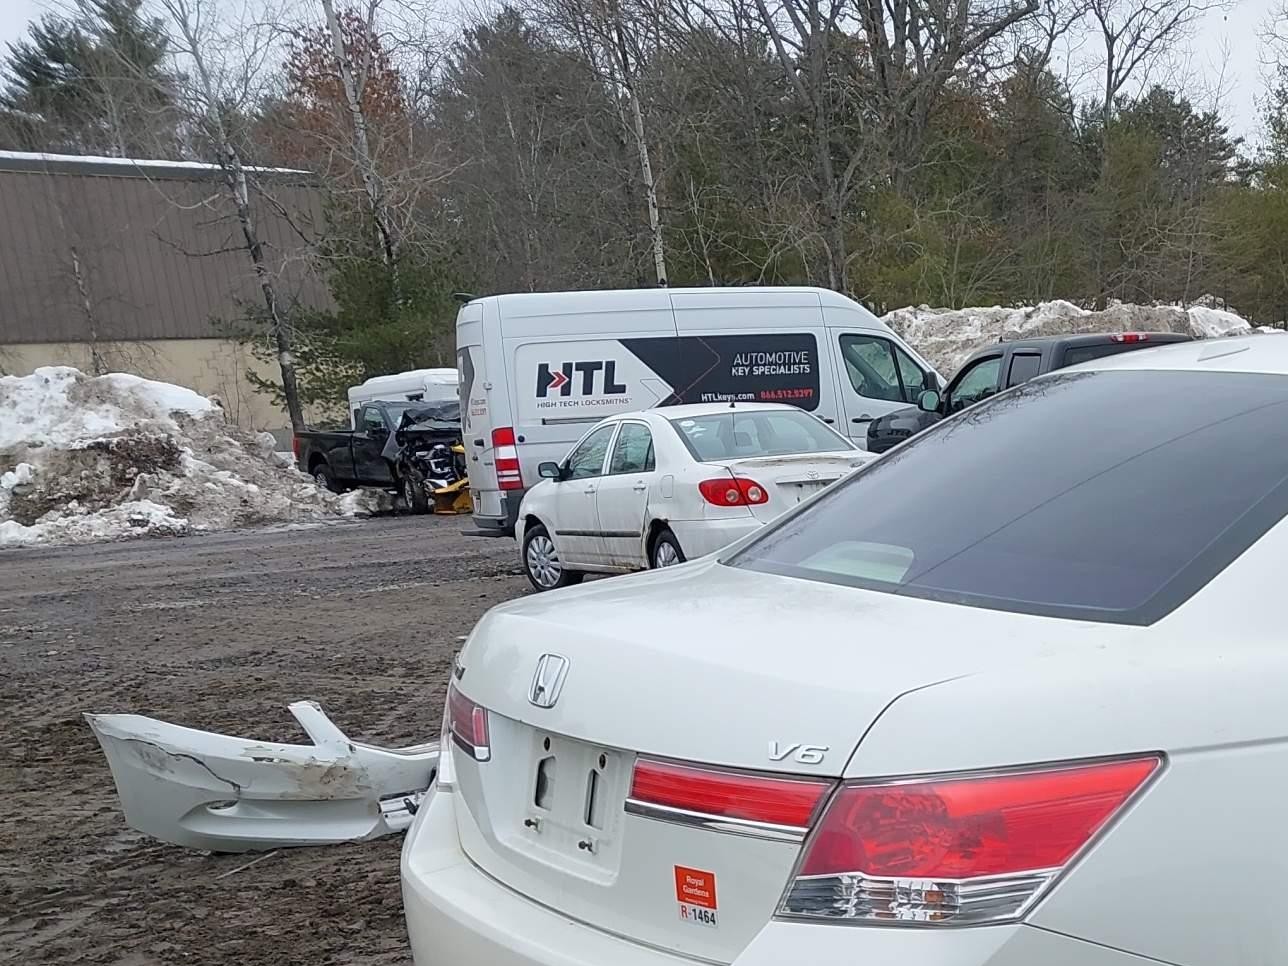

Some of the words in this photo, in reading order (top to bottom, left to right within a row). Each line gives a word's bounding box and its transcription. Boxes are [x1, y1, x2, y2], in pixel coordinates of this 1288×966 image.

[733, 351, 809, 366] AUTOMOTIVE
[731, 366, 751, 377] KEY
[752, 364, 811, 375] SPECIALISTS
[536, 360, 627, 398] HTL
[537, 401, 557, 409] HIGH
[559, 400, 579, 408] TECH
[767, 740, 830, 765] V6
[686, 875, 705, 887] Royal
[682, 884, 709, 898] Gardens
[680, 904, 716, 925] R-1464
